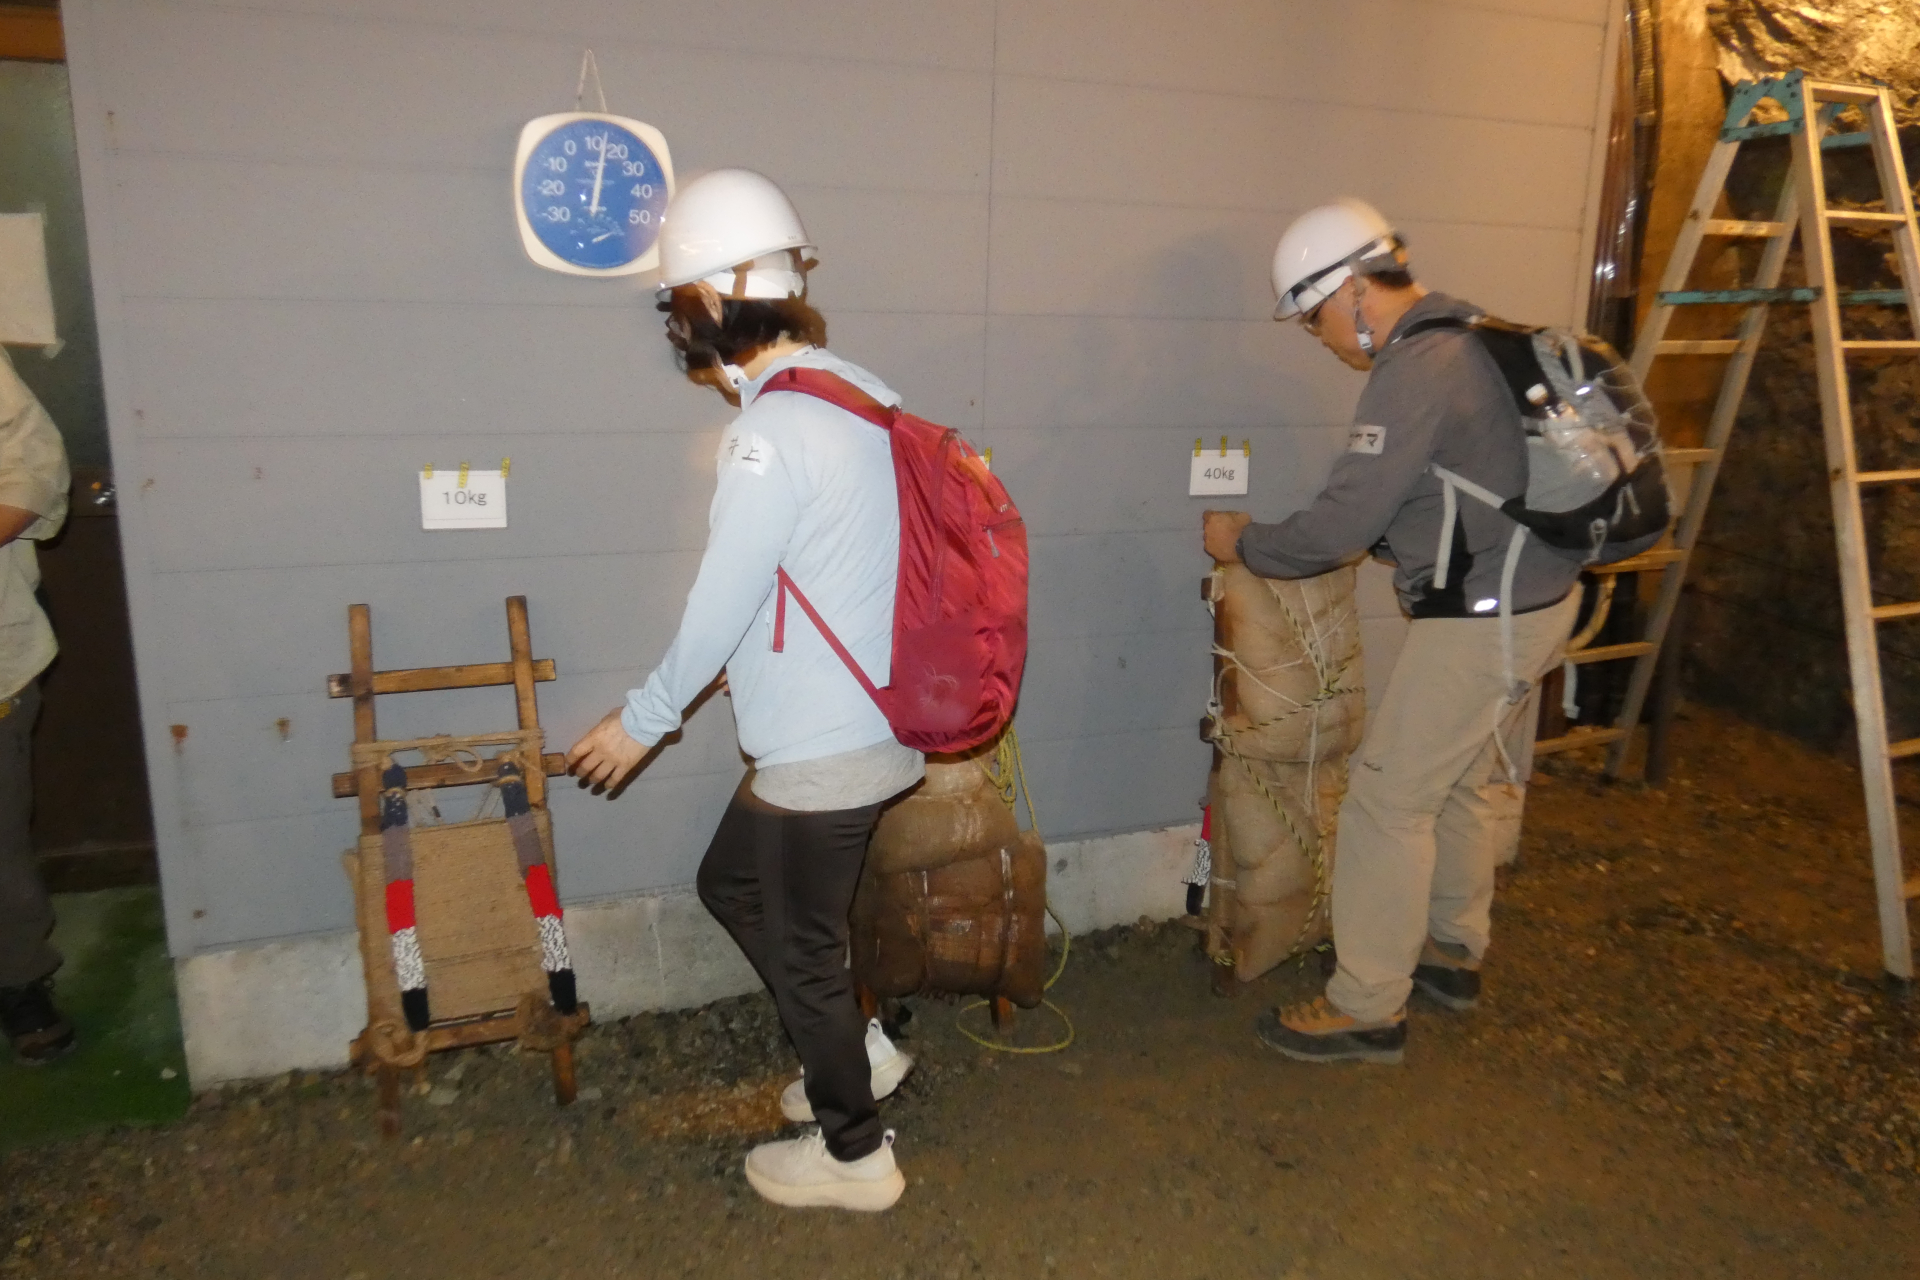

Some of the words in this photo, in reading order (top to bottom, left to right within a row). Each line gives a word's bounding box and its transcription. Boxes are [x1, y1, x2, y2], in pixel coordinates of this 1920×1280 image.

[564, 140, 577, 156] 0
[606, 143, 628, 160] 20
[622, 161, 645, 177] 30
[630, 184, 653, 199] 40
[629, 209, 651, 224] 50
[1204, 466, 1236, 481] 40kg
[442, 490, 487, 506] 10kg
